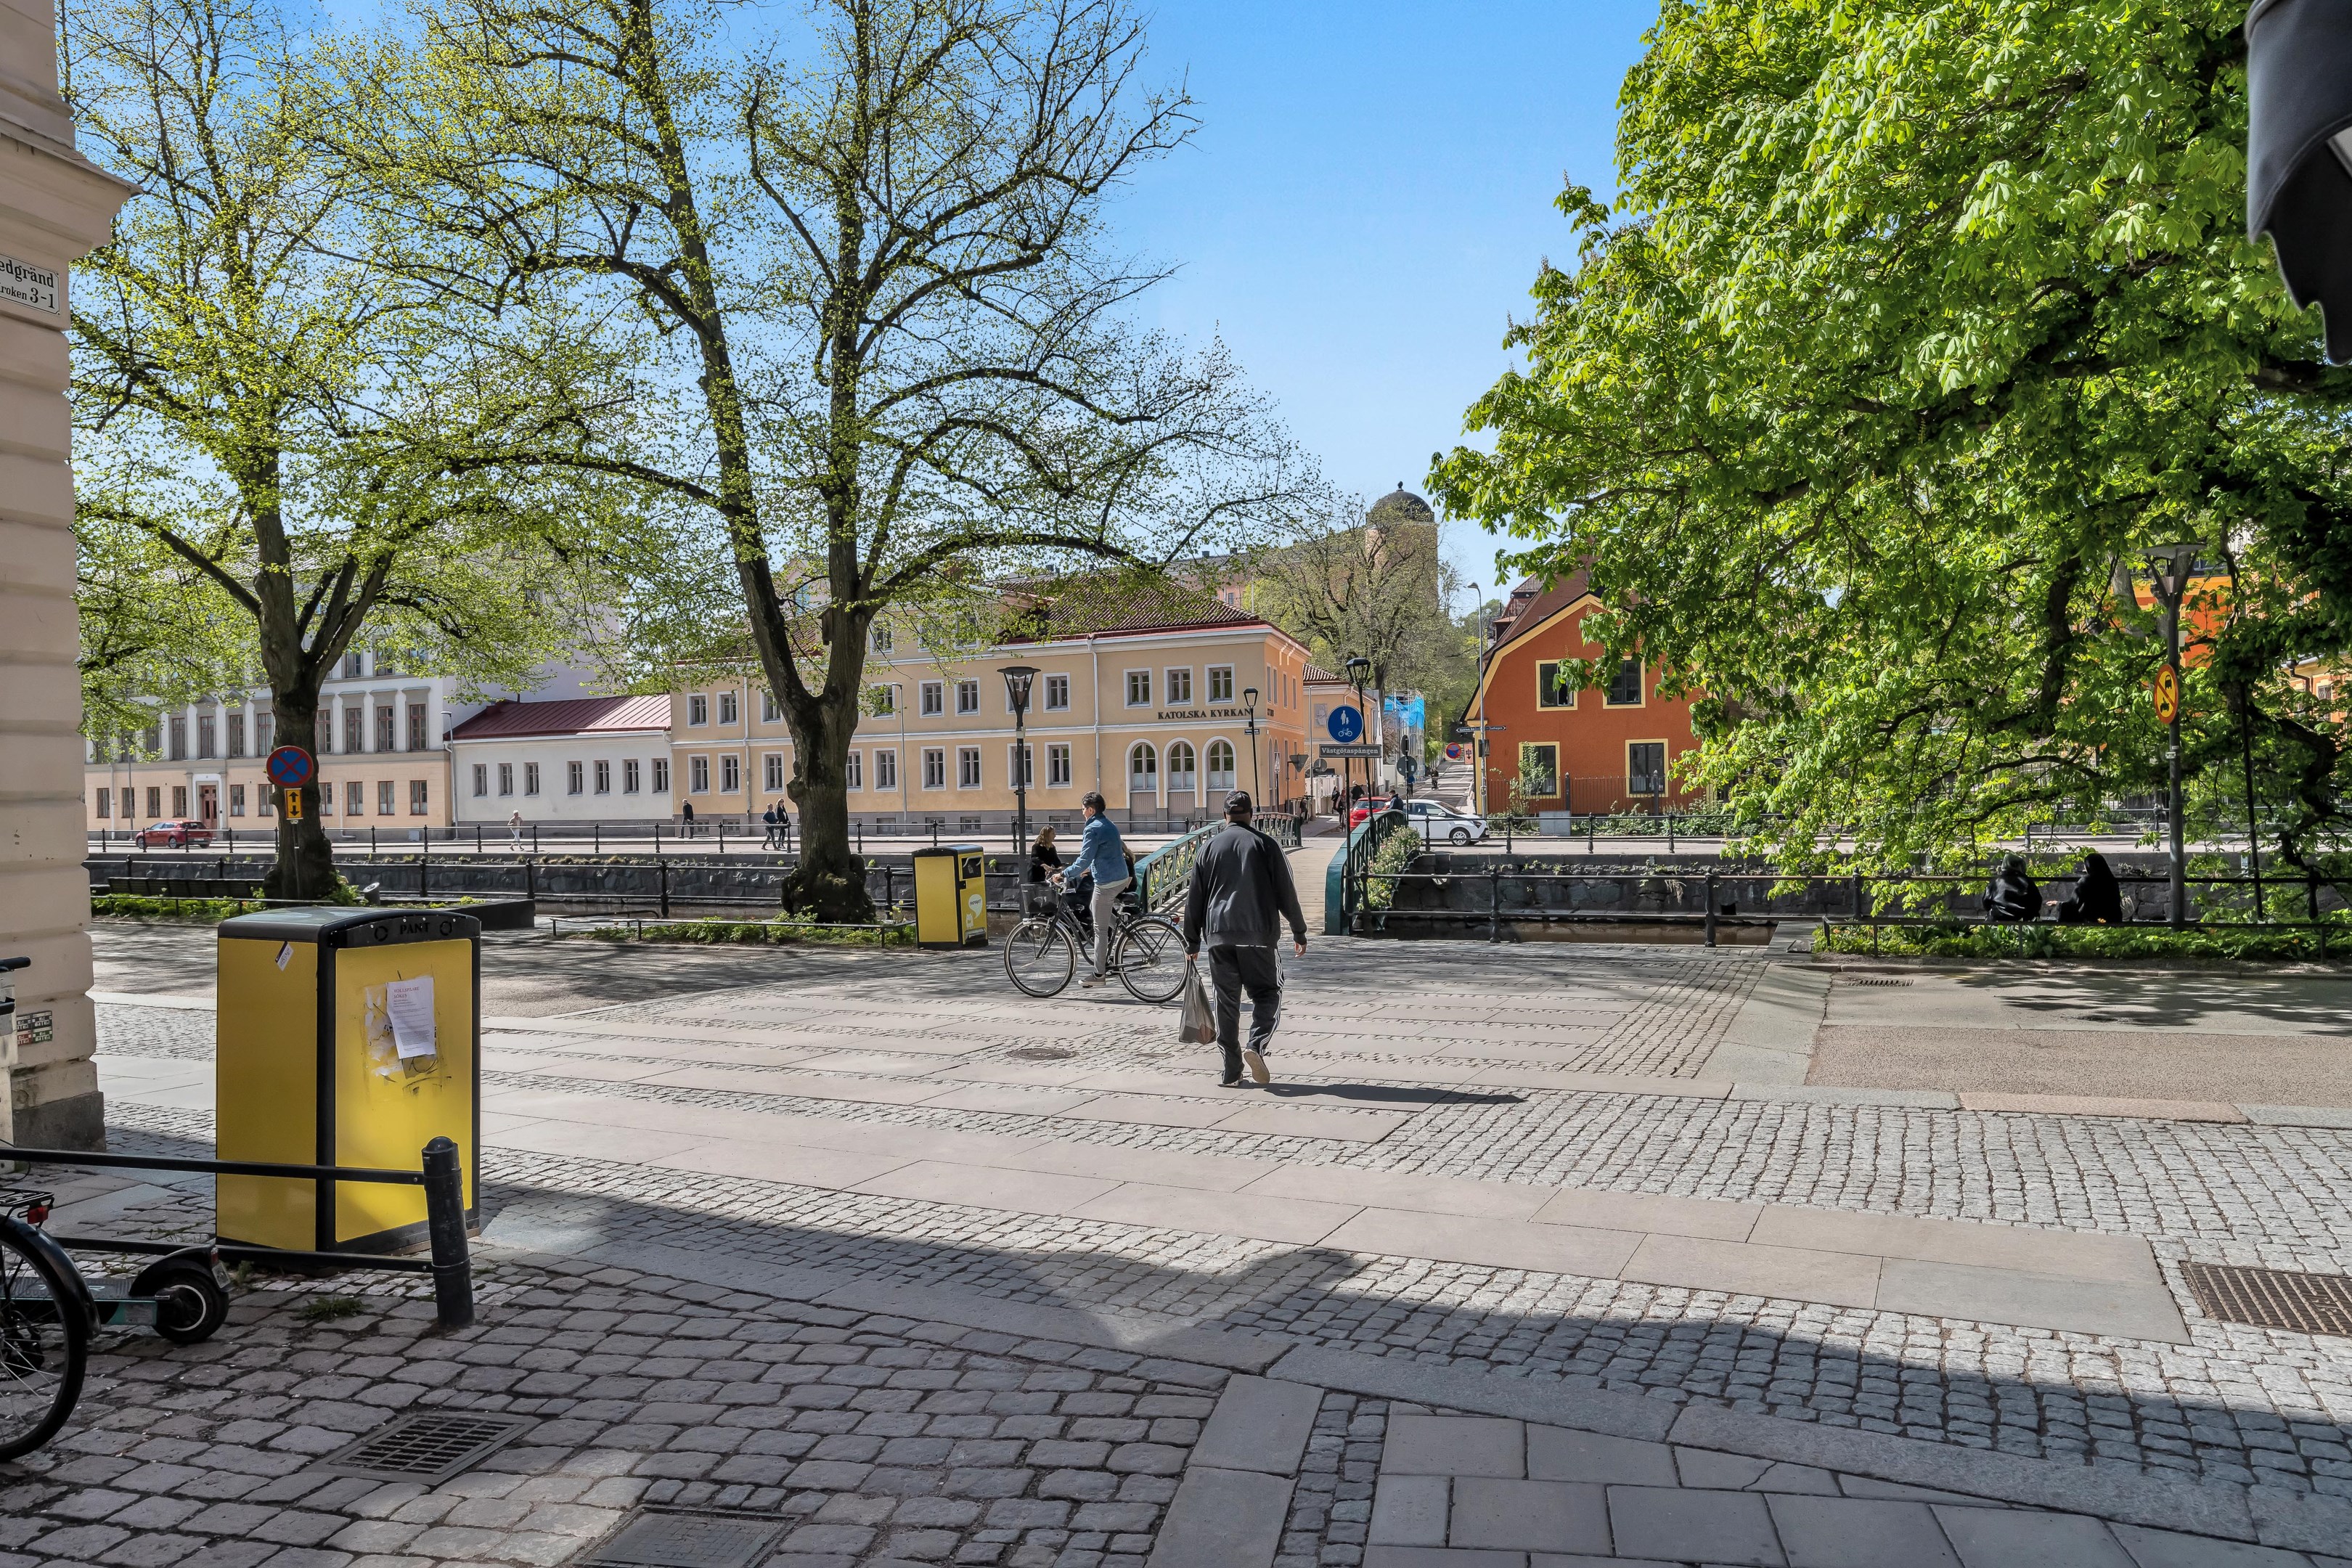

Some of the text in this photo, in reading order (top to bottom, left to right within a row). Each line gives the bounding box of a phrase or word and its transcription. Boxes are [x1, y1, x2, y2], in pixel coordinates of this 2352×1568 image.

[0, 282, 55, 309] roken 3-1
[1158, 708, 1251, 719] KATOLSKA KYRKAN
[400, 922, 430, 935] PANT
